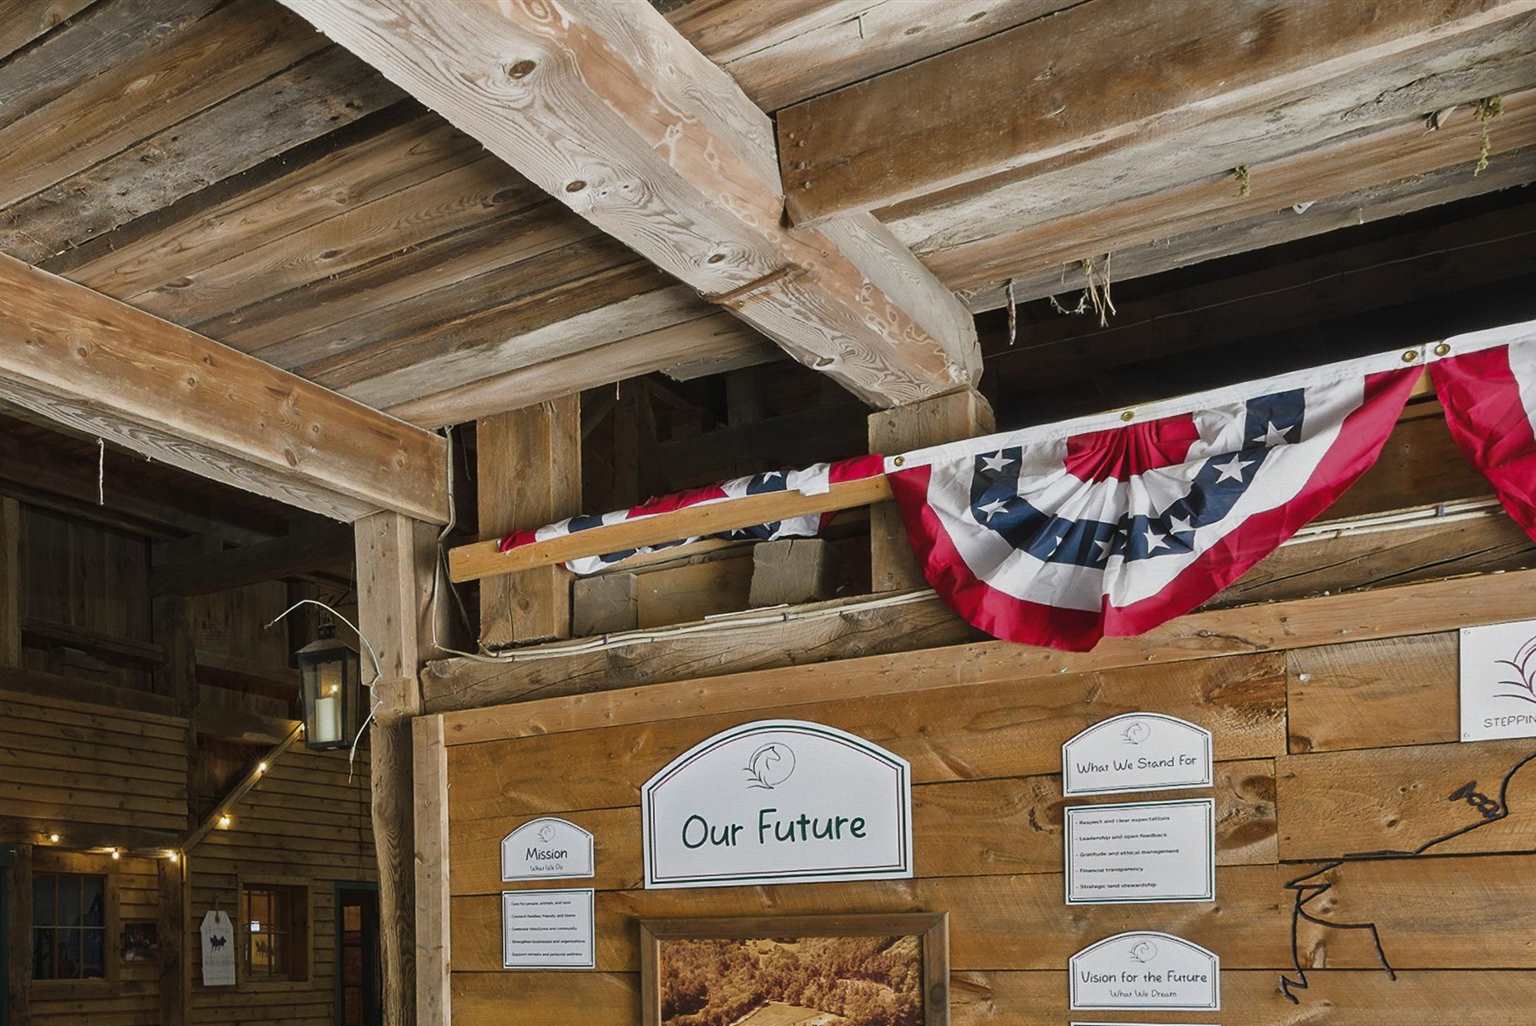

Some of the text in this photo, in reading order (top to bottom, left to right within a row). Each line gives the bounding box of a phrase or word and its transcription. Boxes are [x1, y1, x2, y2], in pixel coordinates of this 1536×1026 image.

[1076, 754, 1197, 774] What We Stand For
[682, 808, 866, 849] Our Future
[525, 847, 568, 861] Mission
[1081, 970, 1208, 984] Vision for the Future
[1109, 989, 1132, 998] What
[1151, 989, 1177, 998] Dream
